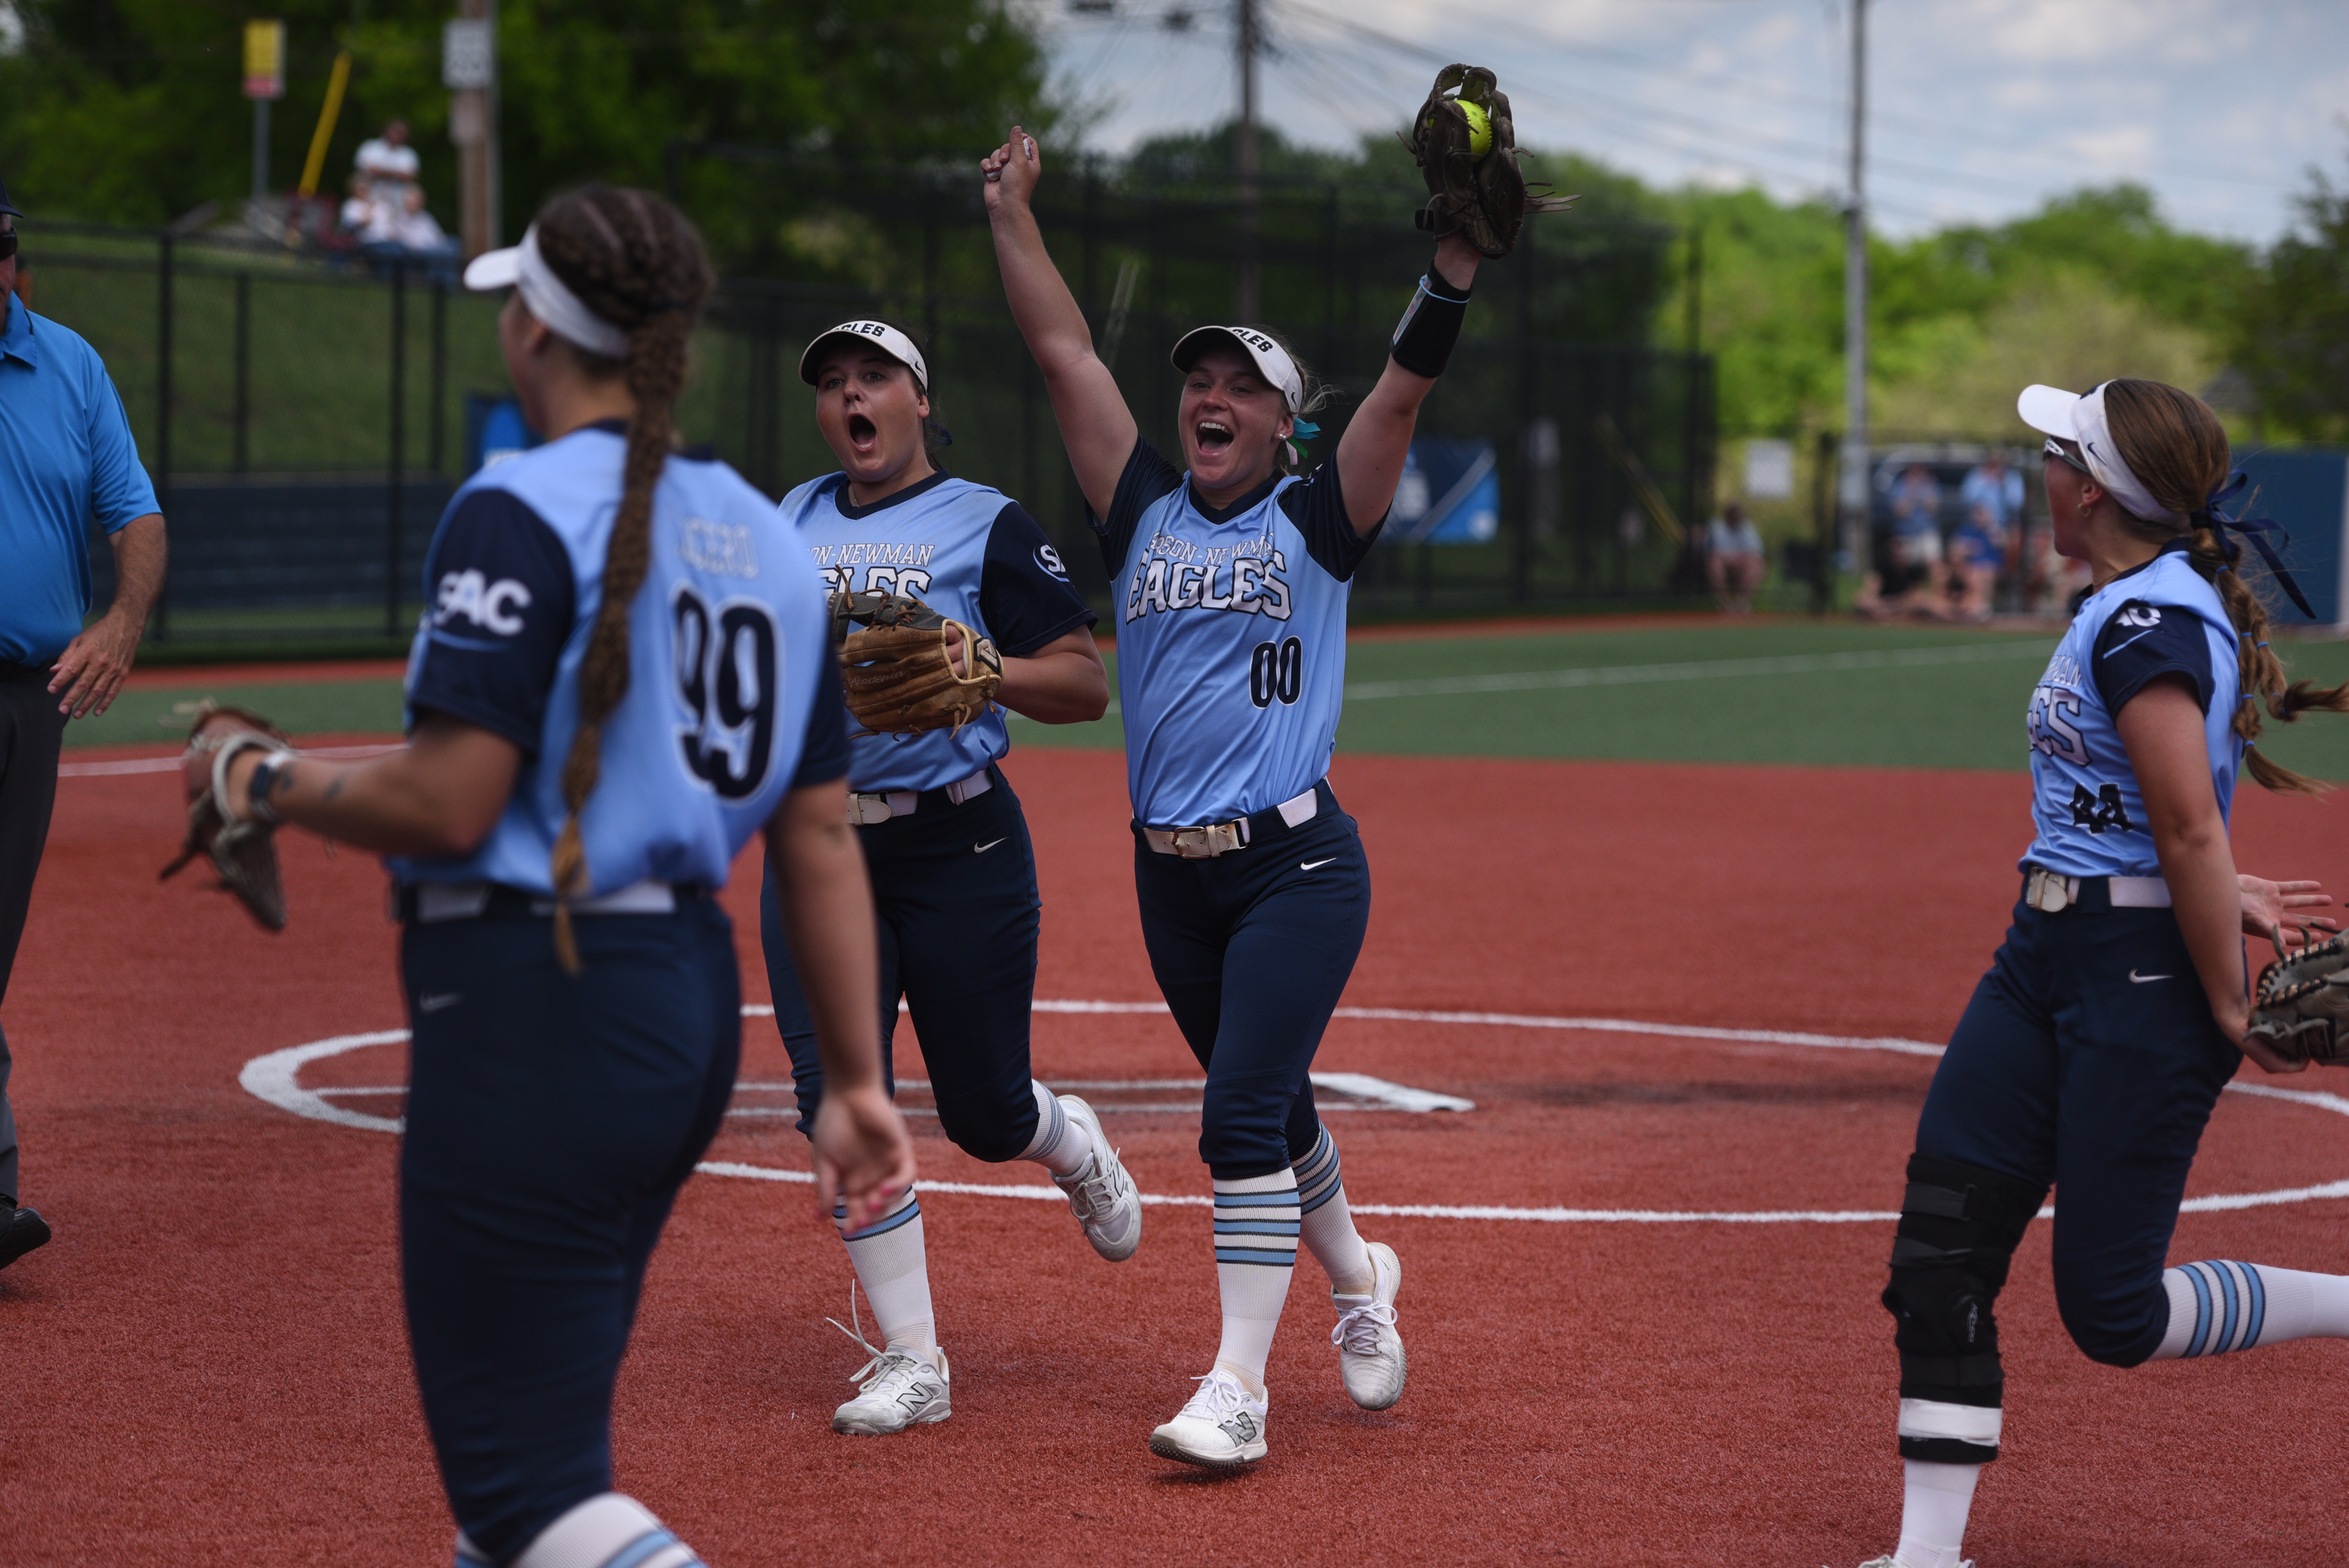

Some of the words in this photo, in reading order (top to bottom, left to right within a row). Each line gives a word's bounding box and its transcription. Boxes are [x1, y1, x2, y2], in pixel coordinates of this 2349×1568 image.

[1126, 547, 1292, 624] EAGLES
[670, 580, 783, 803] 99
[1249, 635, 1303, 710] 00
